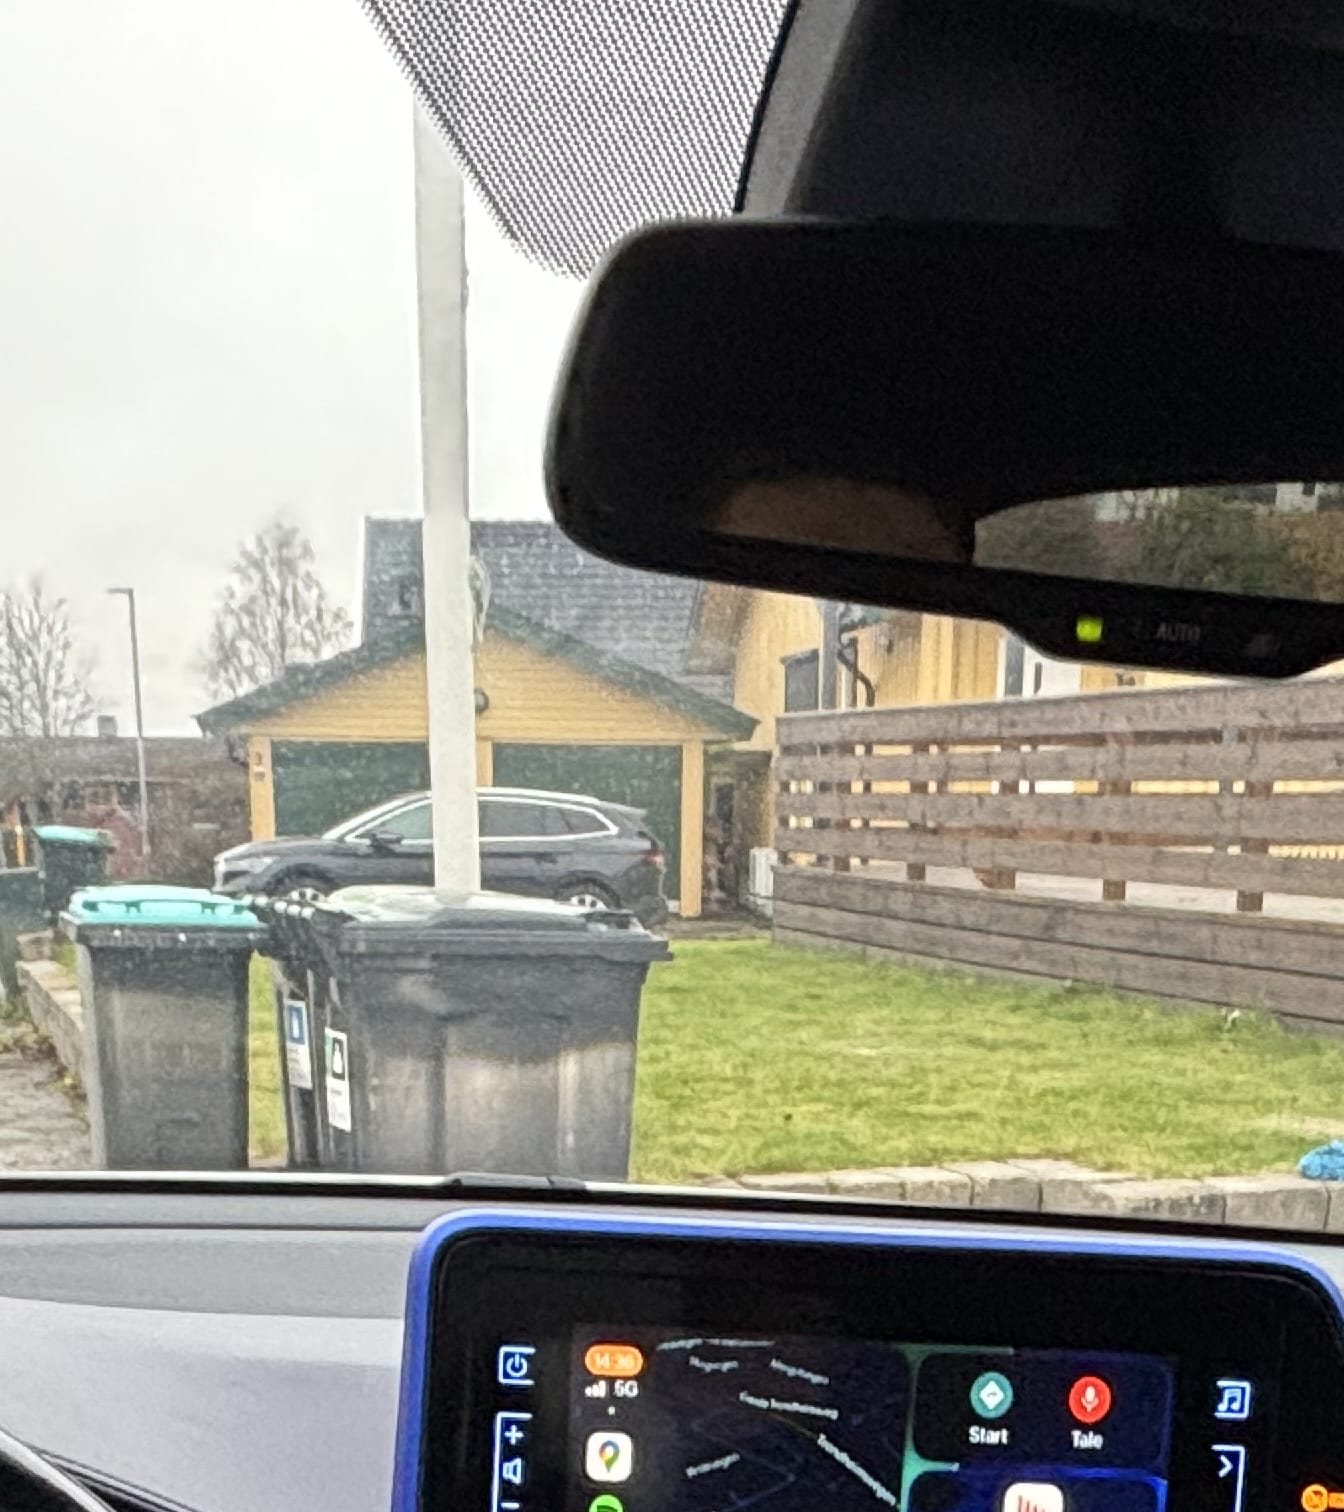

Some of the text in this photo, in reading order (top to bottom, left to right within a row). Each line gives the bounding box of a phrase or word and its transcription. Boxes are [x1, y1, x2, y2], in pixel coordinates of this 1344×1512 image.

[1156, 623, 1201, 642] AUTO
[613, 1380, 638, 1398] 5G
[969, 1426, 1008, 1445] Start
[1071, 1431, 1103, 1450] Tale
